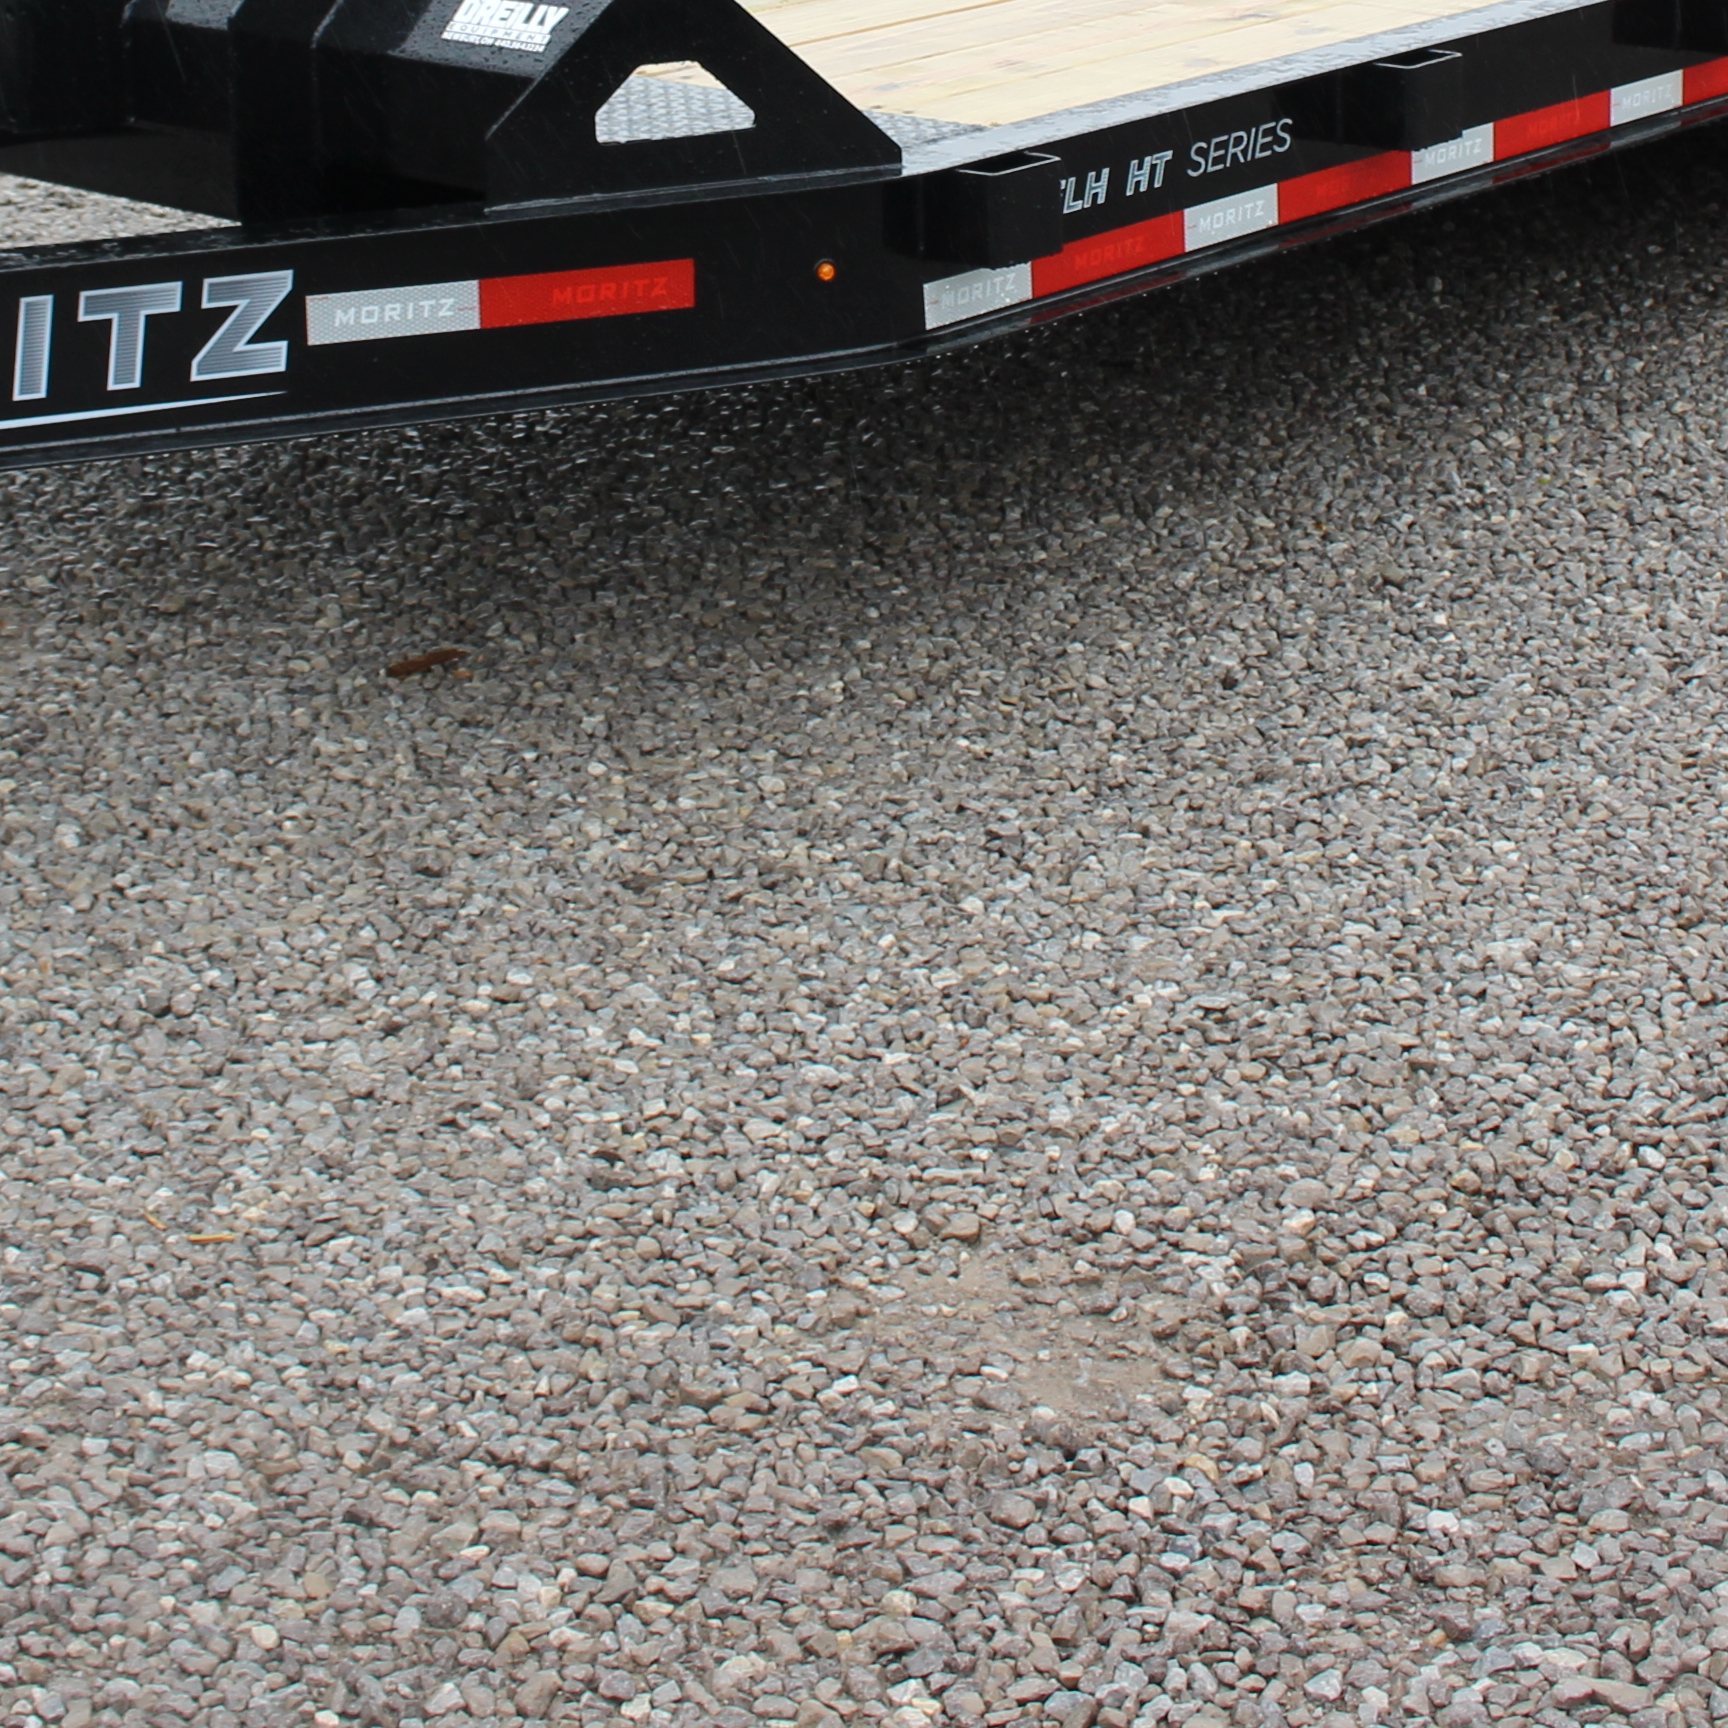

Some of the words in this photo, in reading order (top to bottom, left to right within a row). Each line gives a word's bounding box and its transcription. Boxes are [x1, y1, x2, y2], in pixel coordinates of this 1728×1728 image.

[447, 24, 549, 43] EQUIPMENT
[1125, 150, 1174, 196] HT
[1186, 118, 1293, 177] SERIES
[1425, 139, 1482, 165] MORITZ
[1197, 200, 1265, 233] MORITZ
[551, 276, 669, 307] MORITZ
[941, 272, 1017, 309] MORITZ
[333, 298, 456, 328] MORITZ
